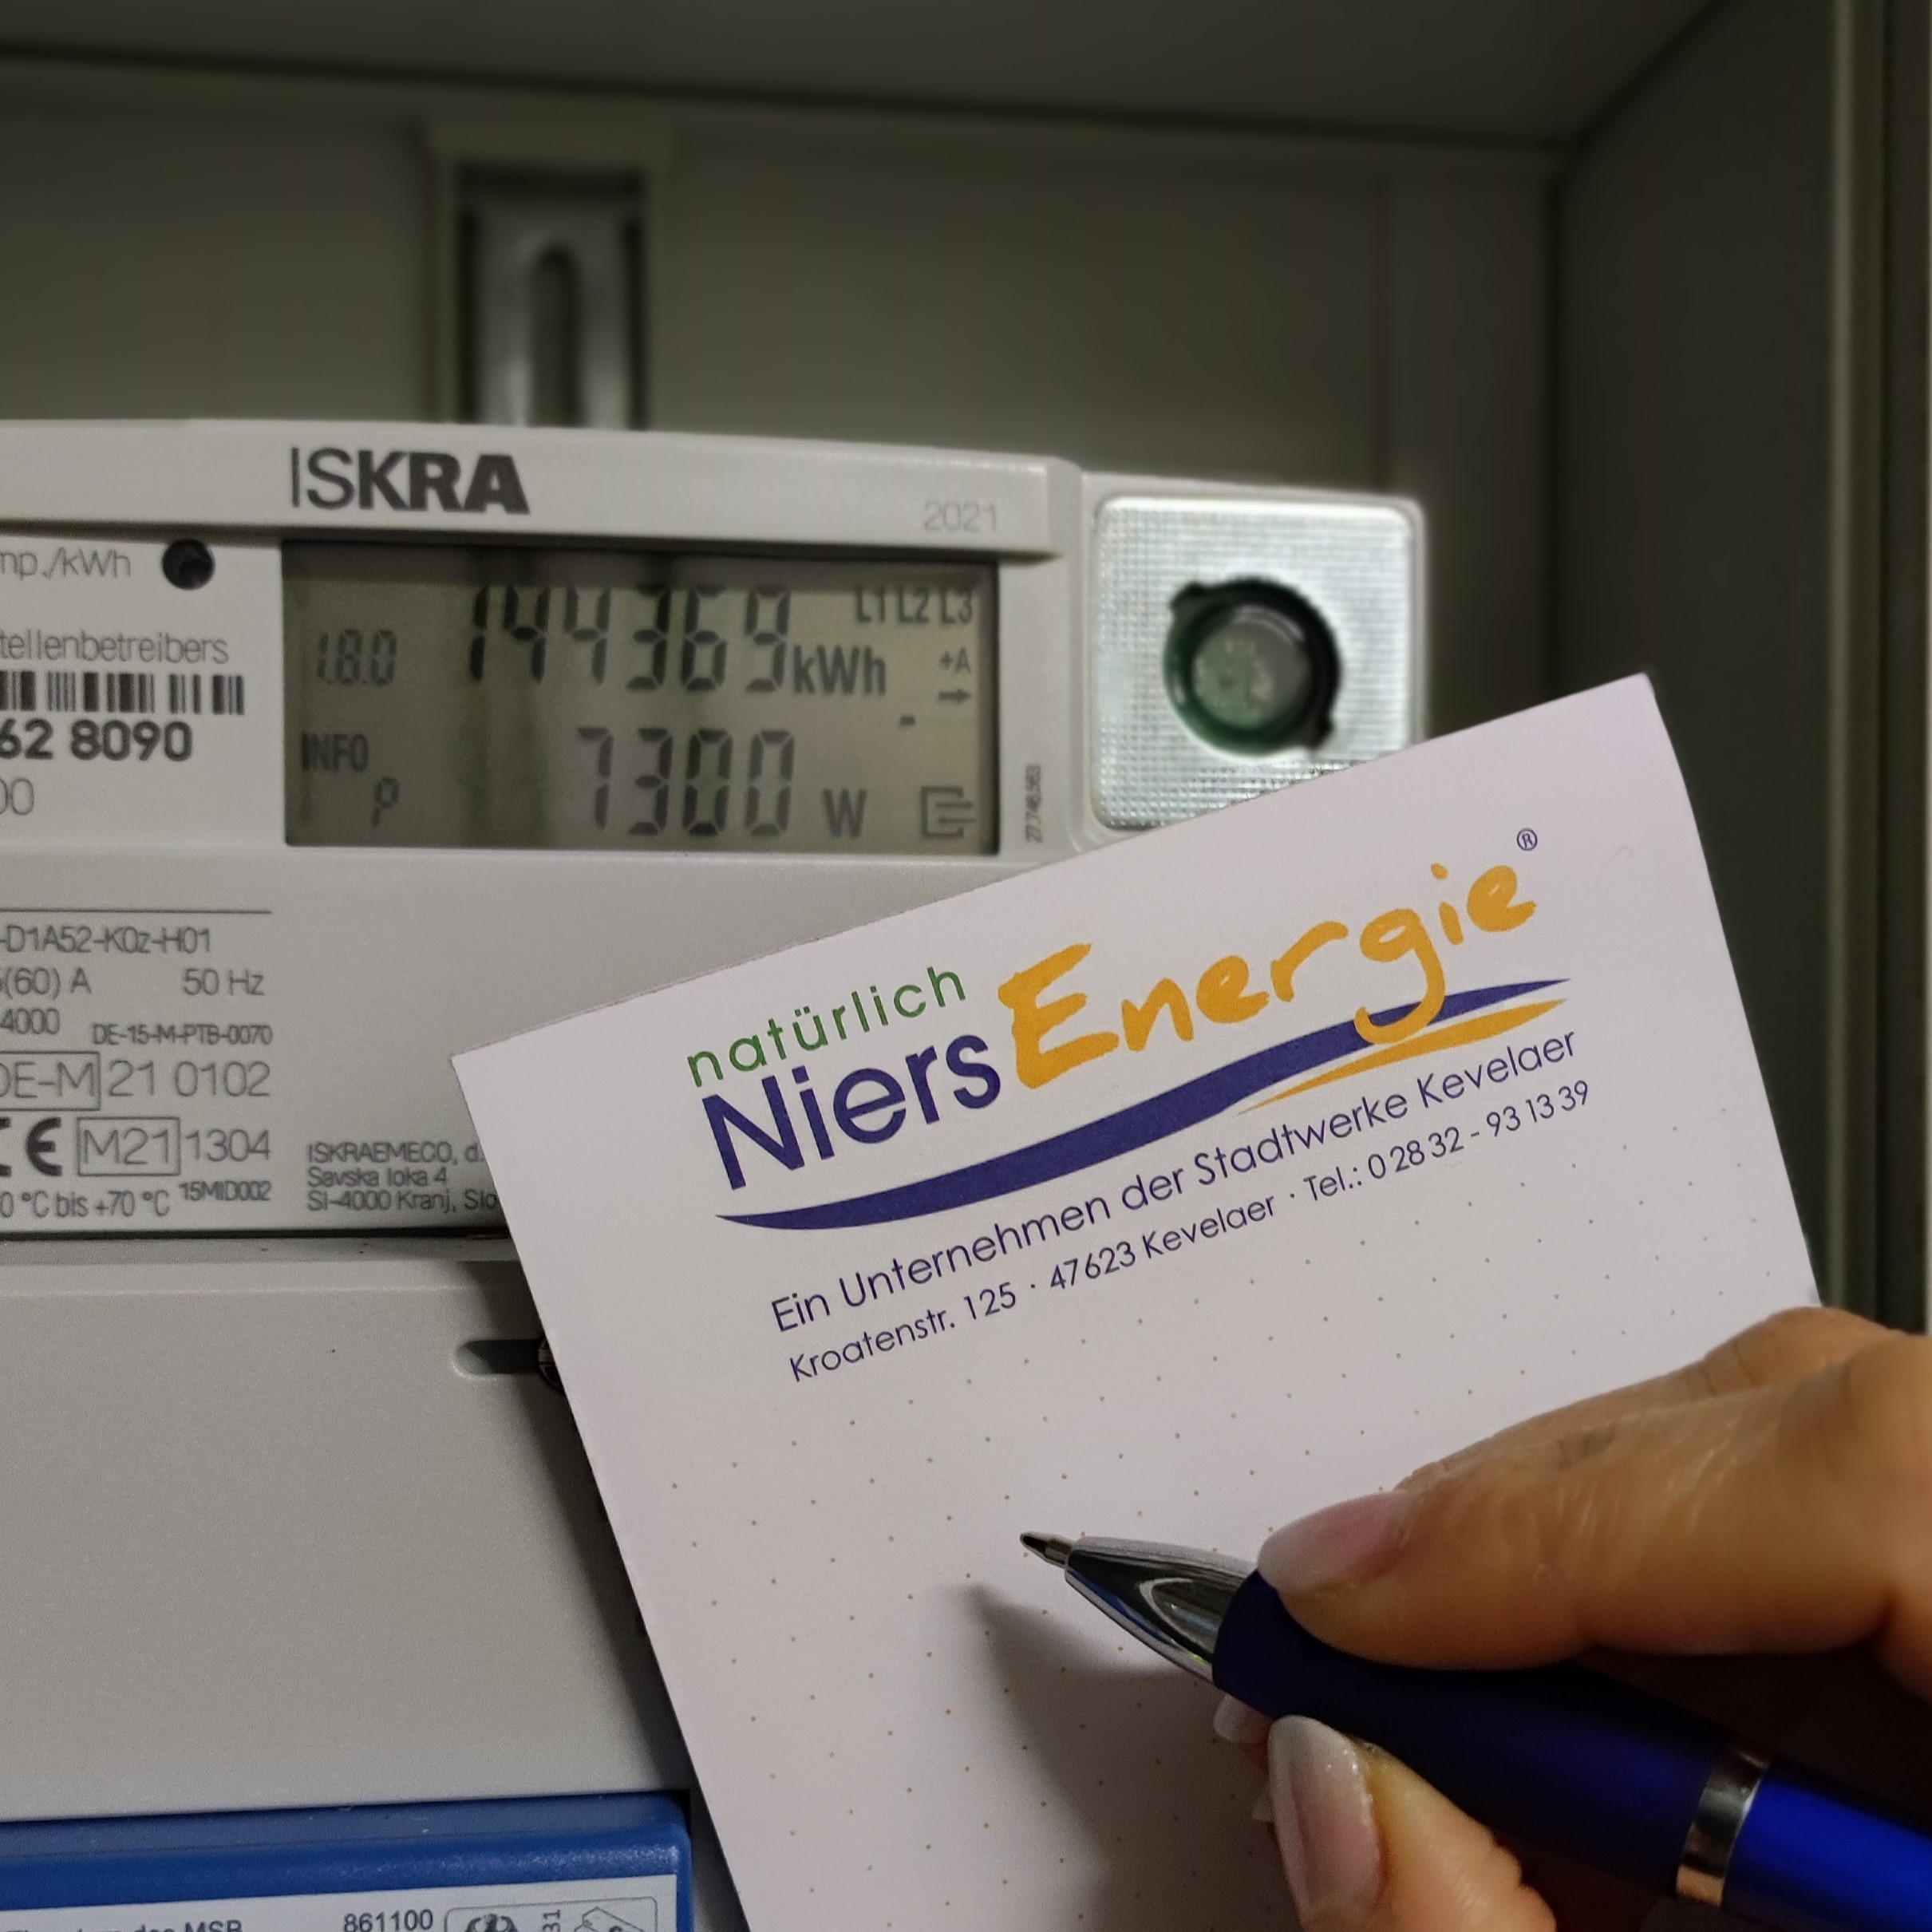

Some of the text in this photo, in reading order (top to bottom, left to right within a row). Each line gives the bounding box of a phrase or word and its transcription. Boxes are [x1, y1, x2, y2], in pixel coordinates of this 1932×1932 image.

[290, 447, 530, 515] ISKRA
[923, 500, 998, 532] 2021
[855, 587, 974, 626] L1 L2 L3
[794, 645, 887, 697] kWh
[0, 717, 193, 762] 62 8090
[301, 732, 369, 773] INFO
[577, 726, 868, 840] 7300 W
[0, 966, 265, 1000] (60) A 50 Hz
[92, 1022, 273, 1045] DE-15-M-PTB-0070
[687, 966, 967, 1088] natürlich
[108, 1059, 156, 1096] 21
[174, 1060, 271, 1097] 0102
[82, 1127, 169, 1164] M21
[184, 1128, 271, 1163] 1304
[307, 1140, 459, 1165] ISKRAEMECO,
[307, 1165, 447, 1188] Savska loka 4
[770, 1030, 1576, 1333] Ein Unternehmen der Stadtwerke Kevelaer
[55, 1190, 89, 1217] bis
[94, 1190, 136, 1218] +70
[397, 1188, 457, 1215] Kranj,
[789, 1308, 957, 1383] Kroatenstr.
[963, 1282, 1017, 1321] 125
[1049, 1241, 1137, 1290] 47623
[1142, 1195, 1277, 1261] Kevelaer
[1302, 1165, 1364, 1203] Tel.:
[343, 1908, 433, 1932] 861100
